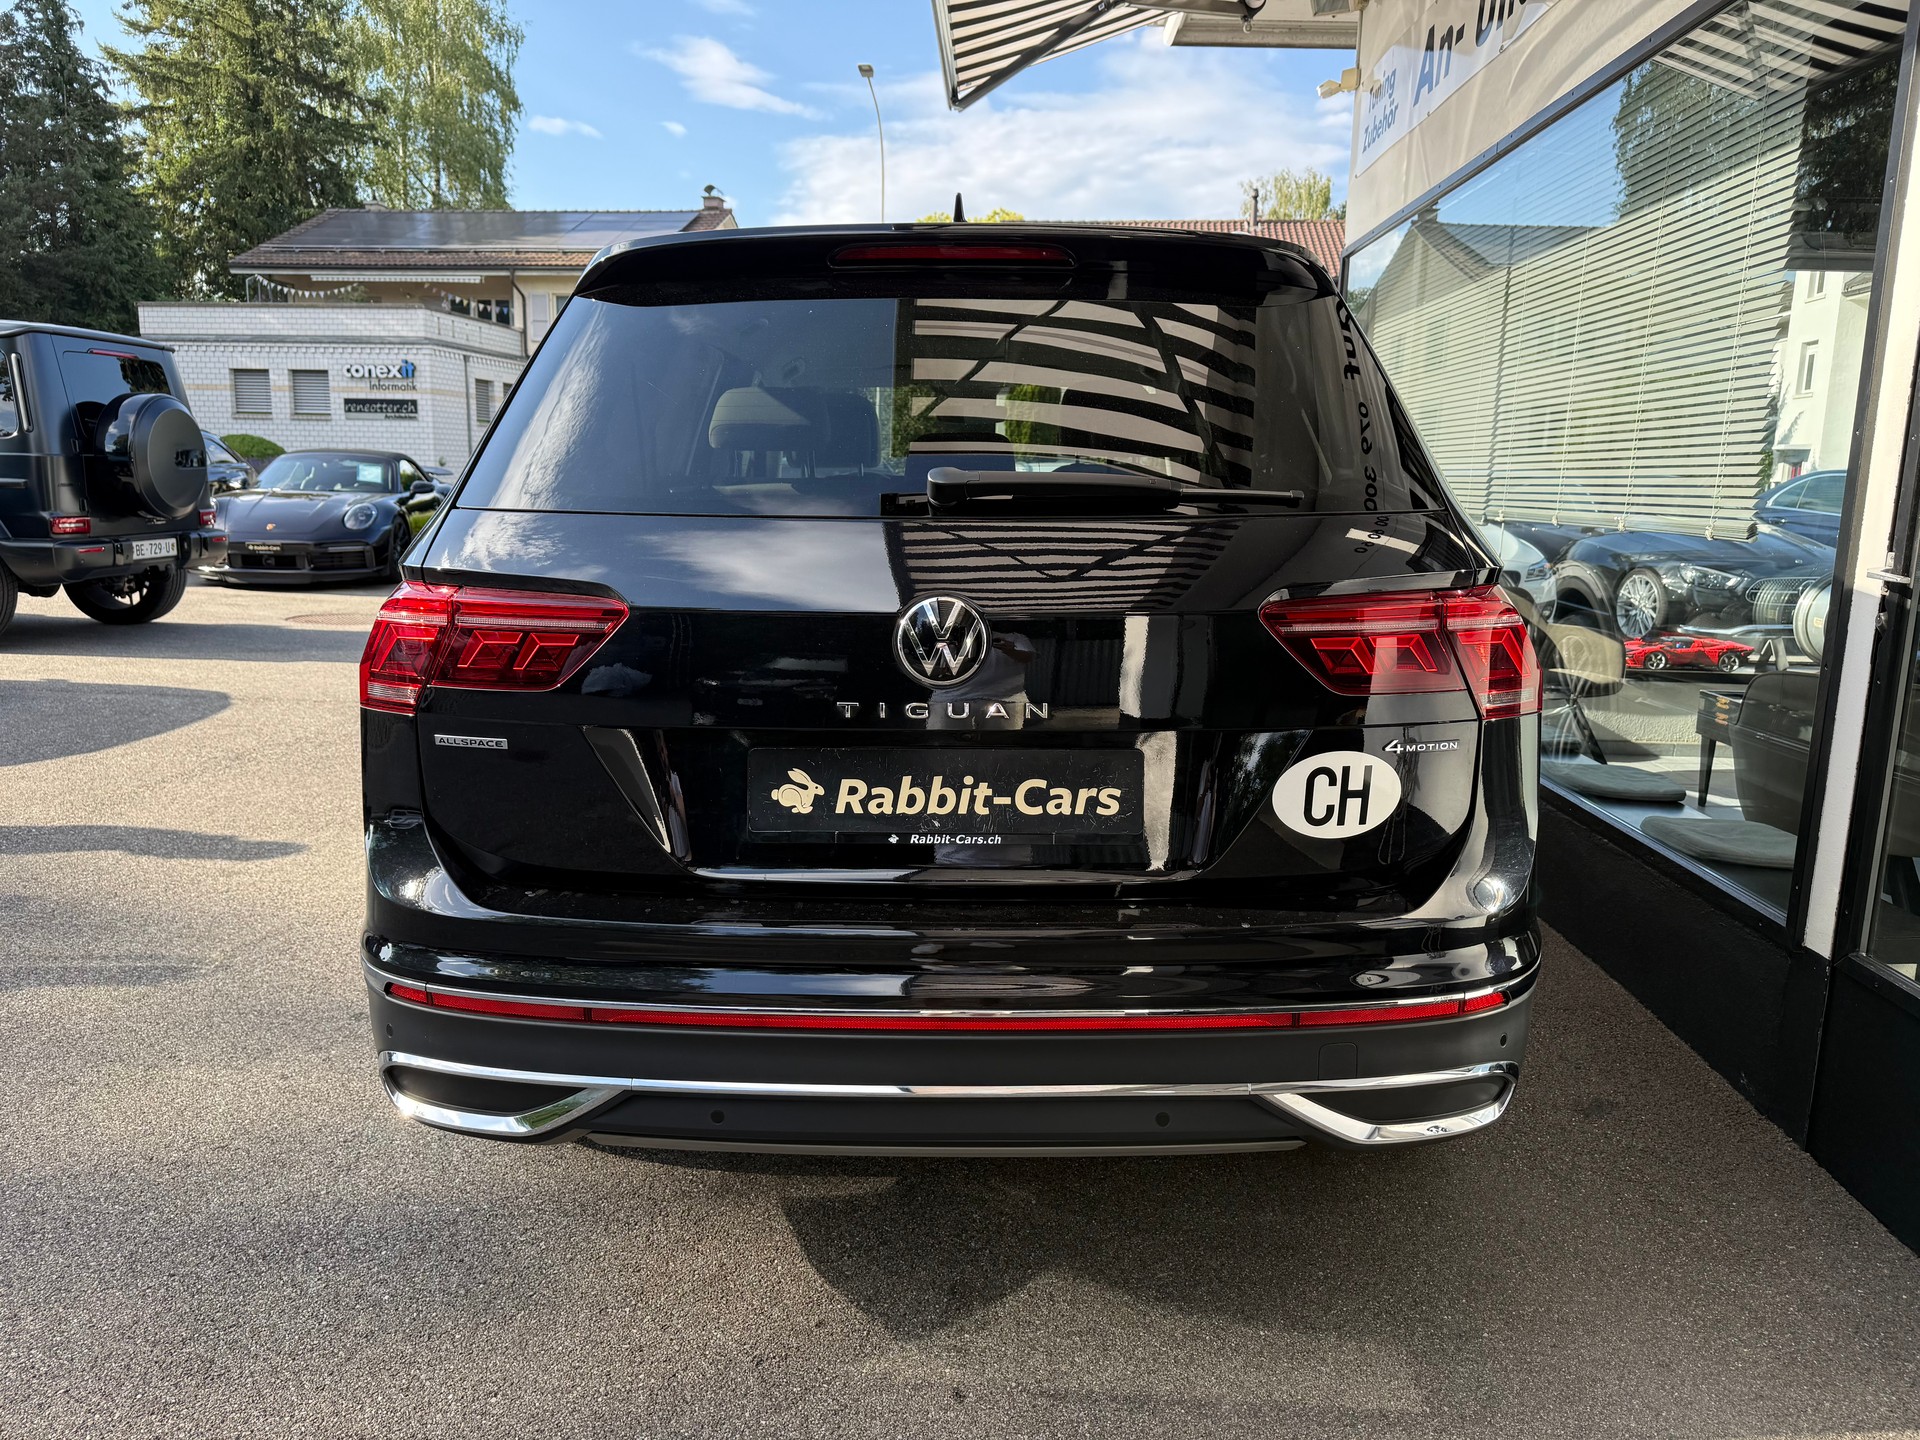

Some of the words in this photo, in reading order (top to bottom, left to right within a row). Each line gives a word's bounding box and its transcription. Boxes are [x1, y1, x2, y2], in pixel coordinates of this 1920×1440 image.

[1413, 23, 1466, 108] An-
[1369, 67, 1397, 114] Tuning
[1361, 99, 1399, 154] Zubehör
[342, 359, 416, 378] conexit
[369, 380, 418, 392] Informatik
[345, 402, 416, 413] reneotter.ch
[836, 701, 1050, 720] TIGUAN
[438, 737, 504, 748] ALLSPACE
[834, 776, 1122, 816] Rabbit-Cars
[1303, 765, 1373, 827] CH
[909, 833, 1002, 845] Rabbit-Cars.ch
